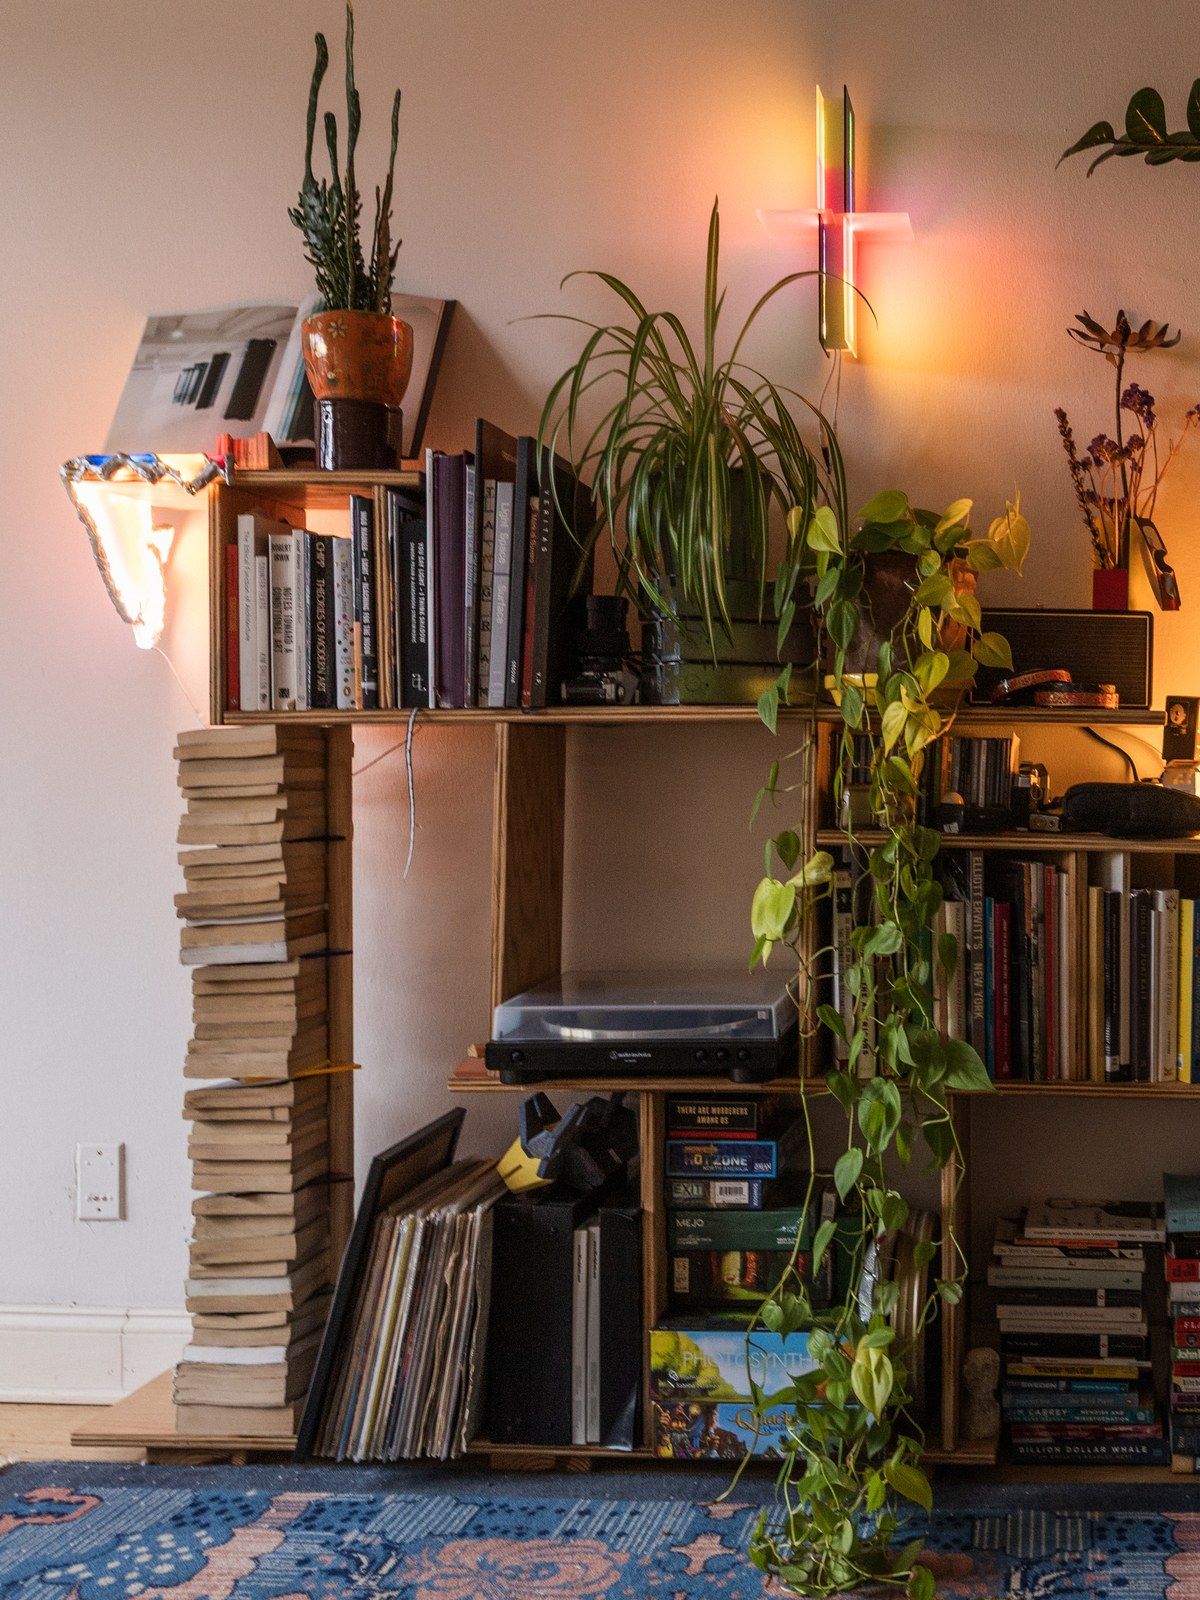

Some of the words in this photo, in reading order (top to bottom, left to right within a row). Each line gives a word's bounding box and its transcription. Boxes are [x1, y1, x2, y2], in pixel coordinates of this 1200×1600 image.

[316, 578, 325, 620] THEORIES
[316, 621, 326, 635] OF
[316, 635, 326, 674] MODERN
[317, 674, 326, 693] ART
[972, 856, 983, 898] ELLIOTT
[972, 900, 984, 950] ERWITT'S
[973, 963, 984, 986] NEW
[974, 990, 985, 1020] YORK
[1176, 1350, 1198, 1360] John
[1018, 1446, 1061, 1454] BILLION
[1066, 1446, 1106, 1454] DOLLAR
[1110, 1446, 1148, 1454] WHALE
